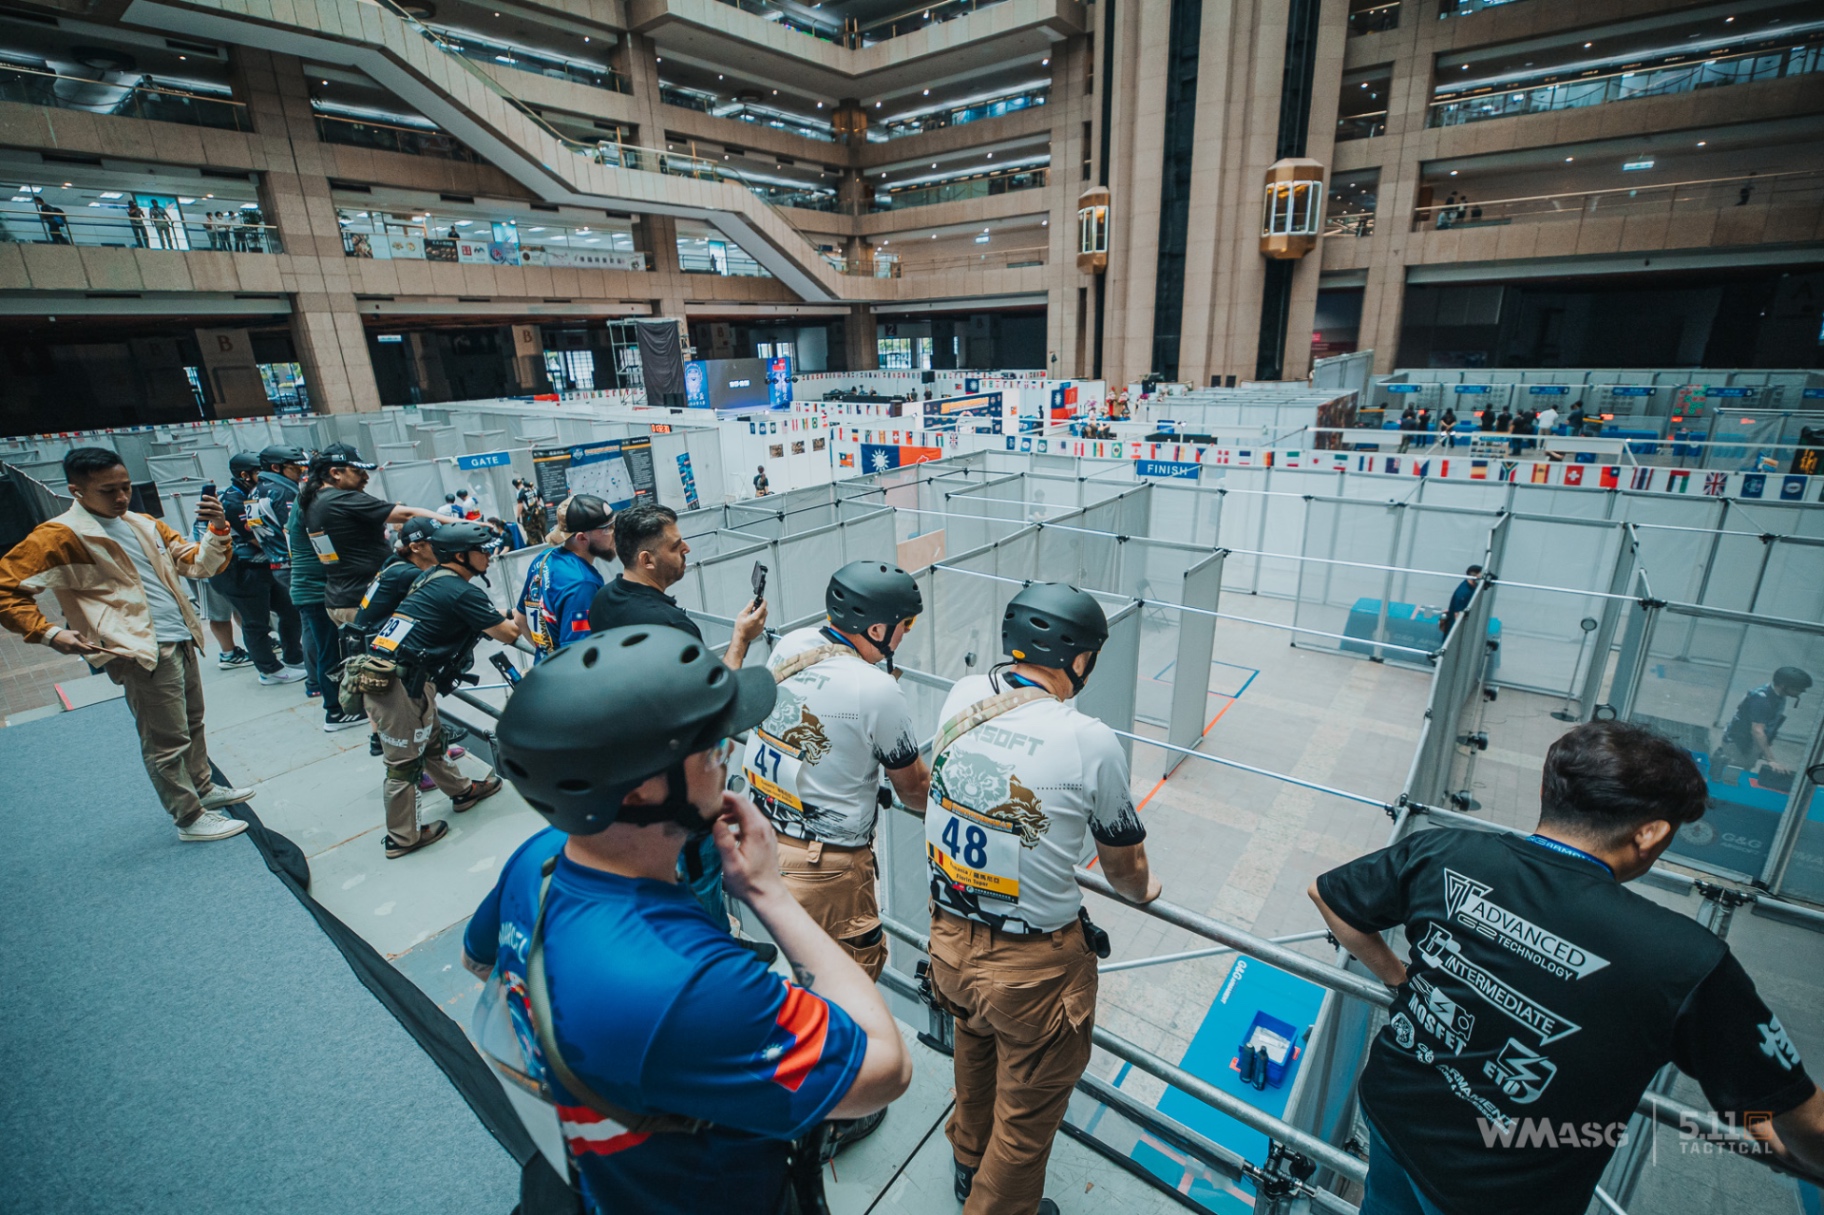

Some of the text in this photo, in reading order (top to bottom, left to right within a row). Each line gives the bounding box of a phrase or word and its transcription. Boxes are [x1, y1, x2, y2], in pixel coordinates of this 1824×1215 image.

[216, 335, 234, 353] B
[523, 329, 533, 343] B
[470, 456, 499, 468] GATE
[1147, 463, 1188, 476] FINISH
[379, 618, 400, 638] 29
[754, 743, 782, 784] 47
[942, 815, 988, 870] 48
[1721, 832, 1763, 849] G&G
[1472, 901, 1587, 968] ADVANCED
[1232, 960, 1248, 981] G&G
[1498, 934, 1574, 981] TECHNOLOGY
[1444, 954, 1556, 1035] INTERMEDIATE
[1408, 993, 1467, 1057] MOSFET
[1436, 1063, 1517, 1127] ARMAMENT
[1483, 1060, 1521, 1096] ETU
